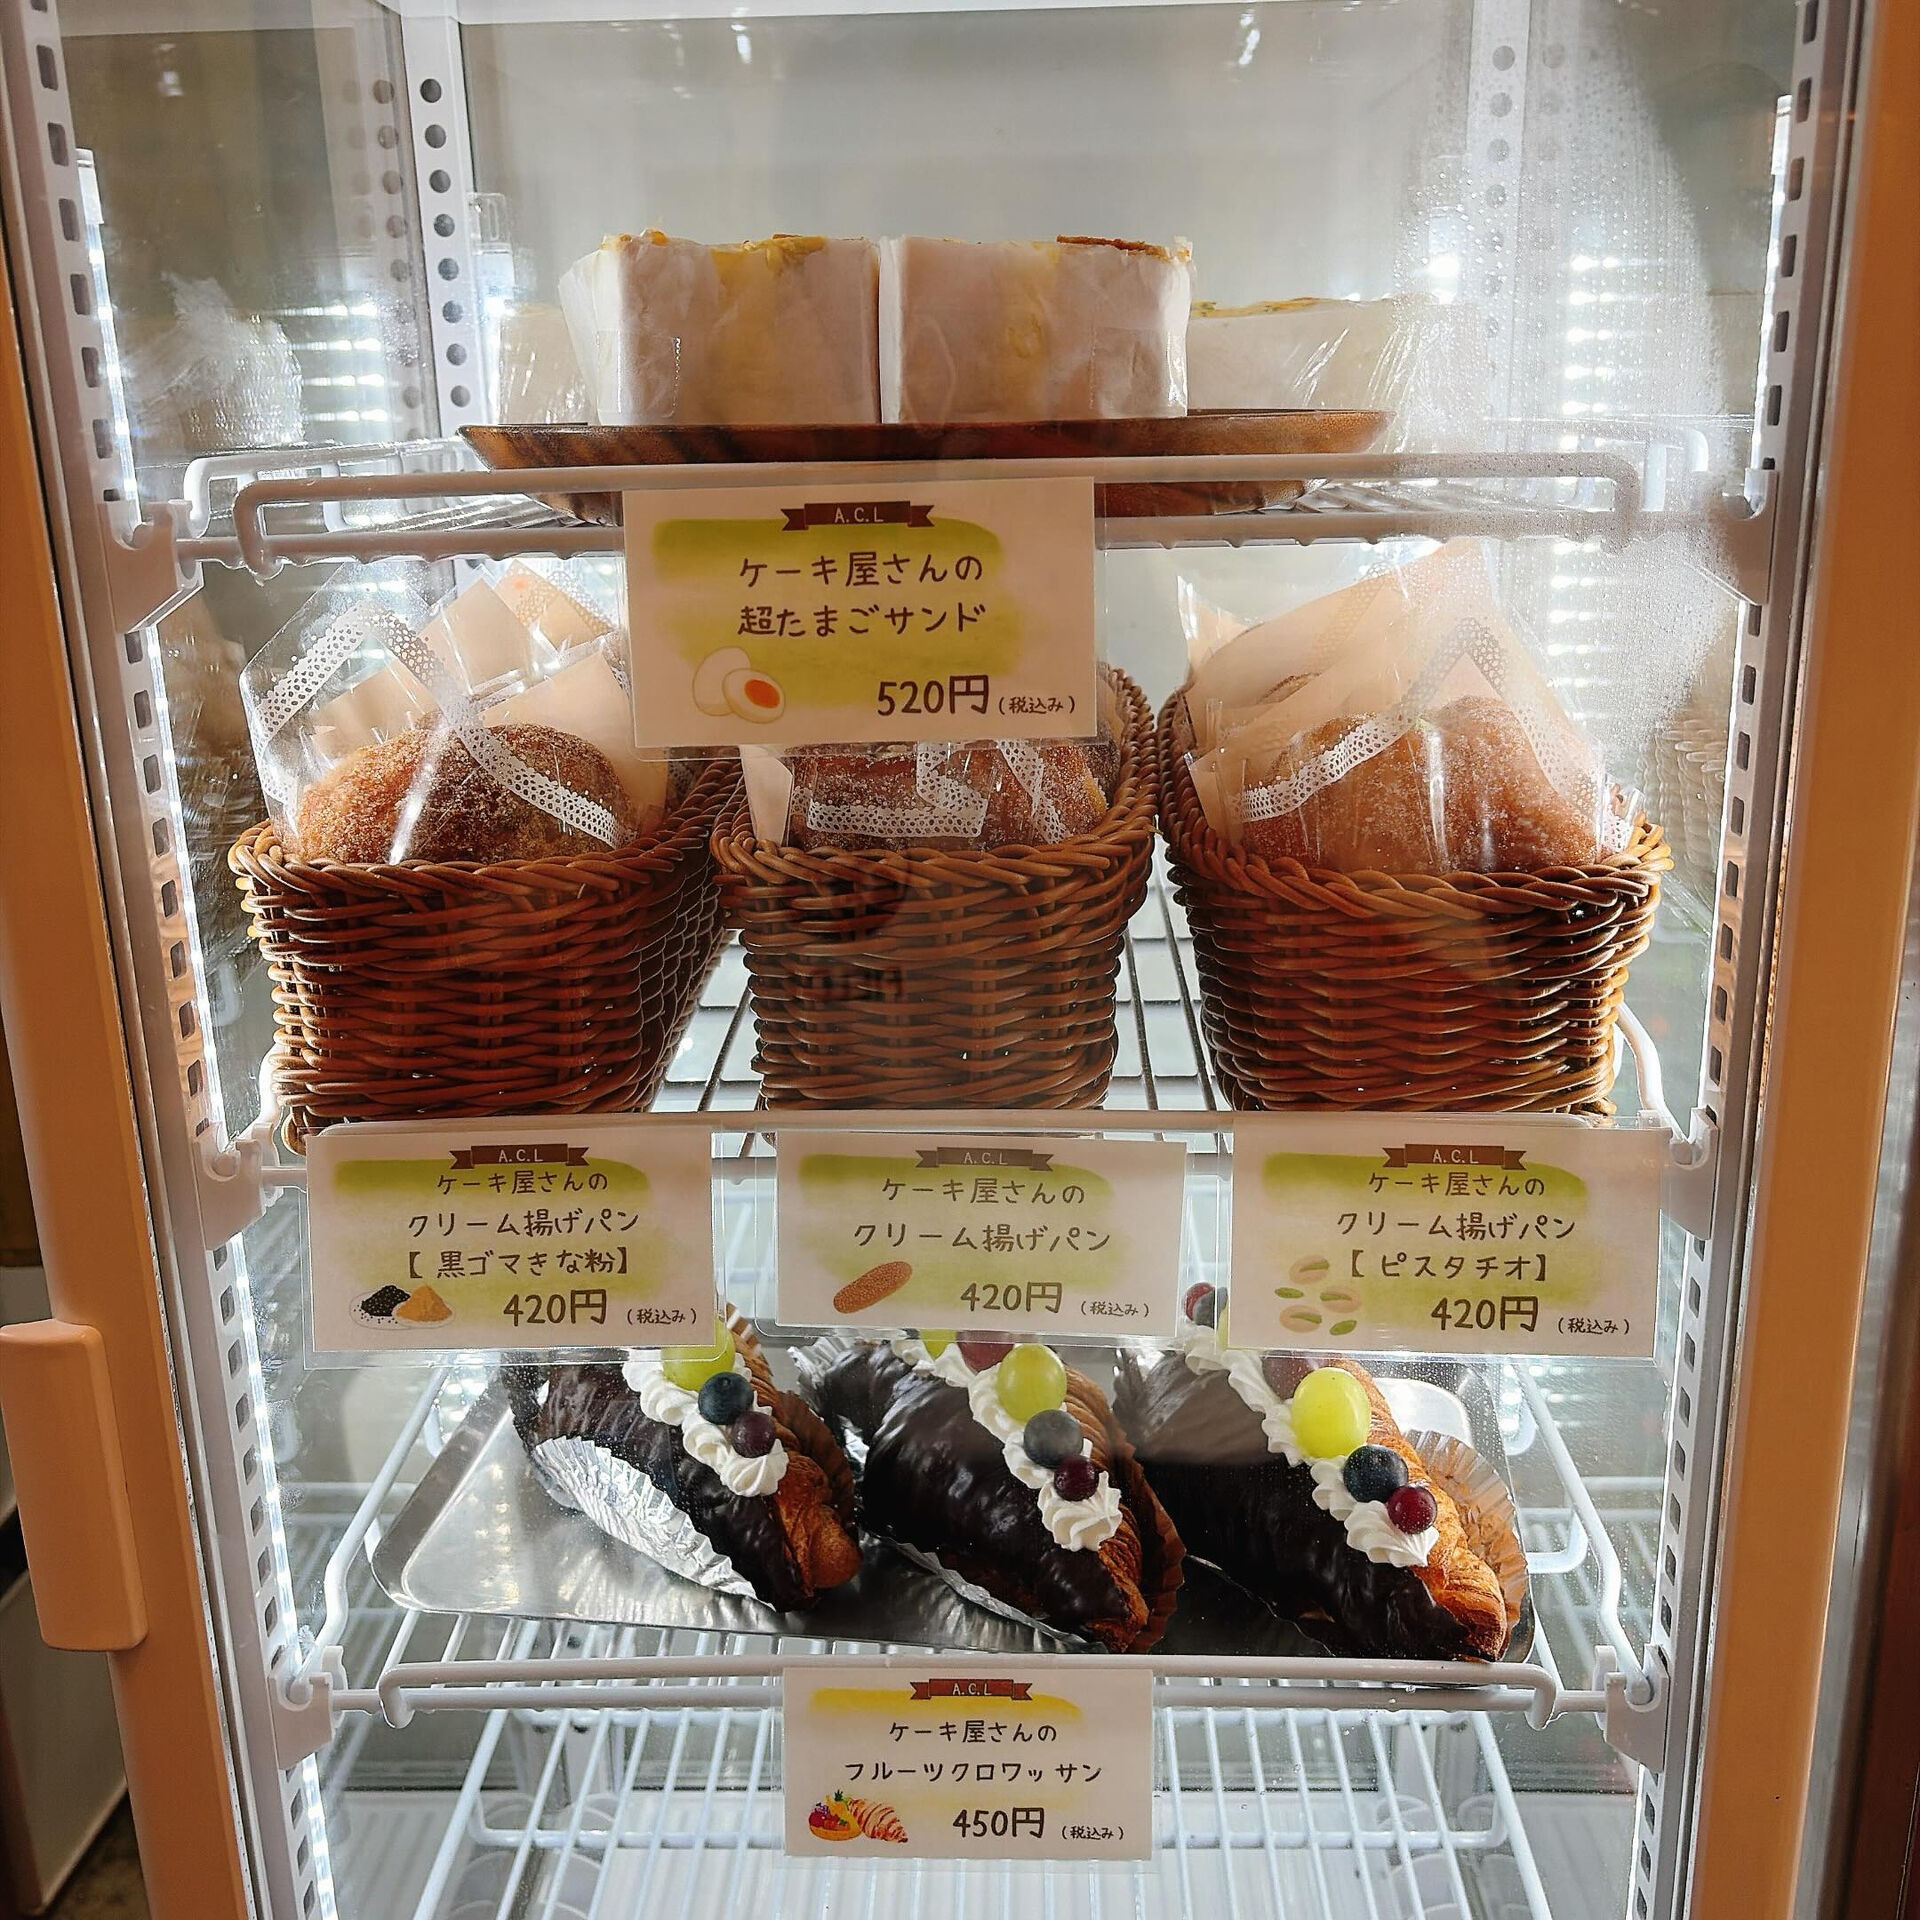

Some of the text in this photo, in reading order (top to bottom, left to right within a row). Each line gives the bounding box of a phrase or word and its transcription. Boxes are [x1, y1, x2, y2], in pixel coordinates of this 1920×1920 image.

[834, 506, 884, 523] A.C.L
[739, 551, 983, 587] ケーキ屋さんの
[738, 603, 986, 637] 超たまごサンド
[876, 675, 1076, 716] 520円 （税込み）
[498, 1148, 544, 1163] A.C.L
[963, 1151, 1008, 1166] A.C.L
[1433, 1149, 1479, 1165] A.C.L
[437, 1170, 608, 1195] ケーキ屋さんの
[882, 1178, 1085, 1205] ケーキ屋さんの
[1368, 1171, 1545, 1196] ケーキ屋さんの
[408, 1208, 640, 1237] クリーム揚げパン
[1337, 1212, 1576, 1241] クリーム揚げパン
[854, 1223, 1110, 1252] クリーム揚げパン
[409, 1247, 629, 1279] 【黒ゴマきな粉】
[1352, 1249, 1547, 1281] 【ピスタチオ】
[503, 1289, 697, 1326] 420円 （税込み）
[960, 1281, 1150, 1317] 420円 （税込み）
[1431, 1296, 1630, 1335] 420円 （税込み）
[952, 1682, 992, 1697] A.C.L
[889, 1720, 1057, 1744] ケーキ屋さんの
[845, 1761, 1102, 1783] フルーツクロワッサン
[952, 1807, 1124, 1841] 450円 （税込み）
